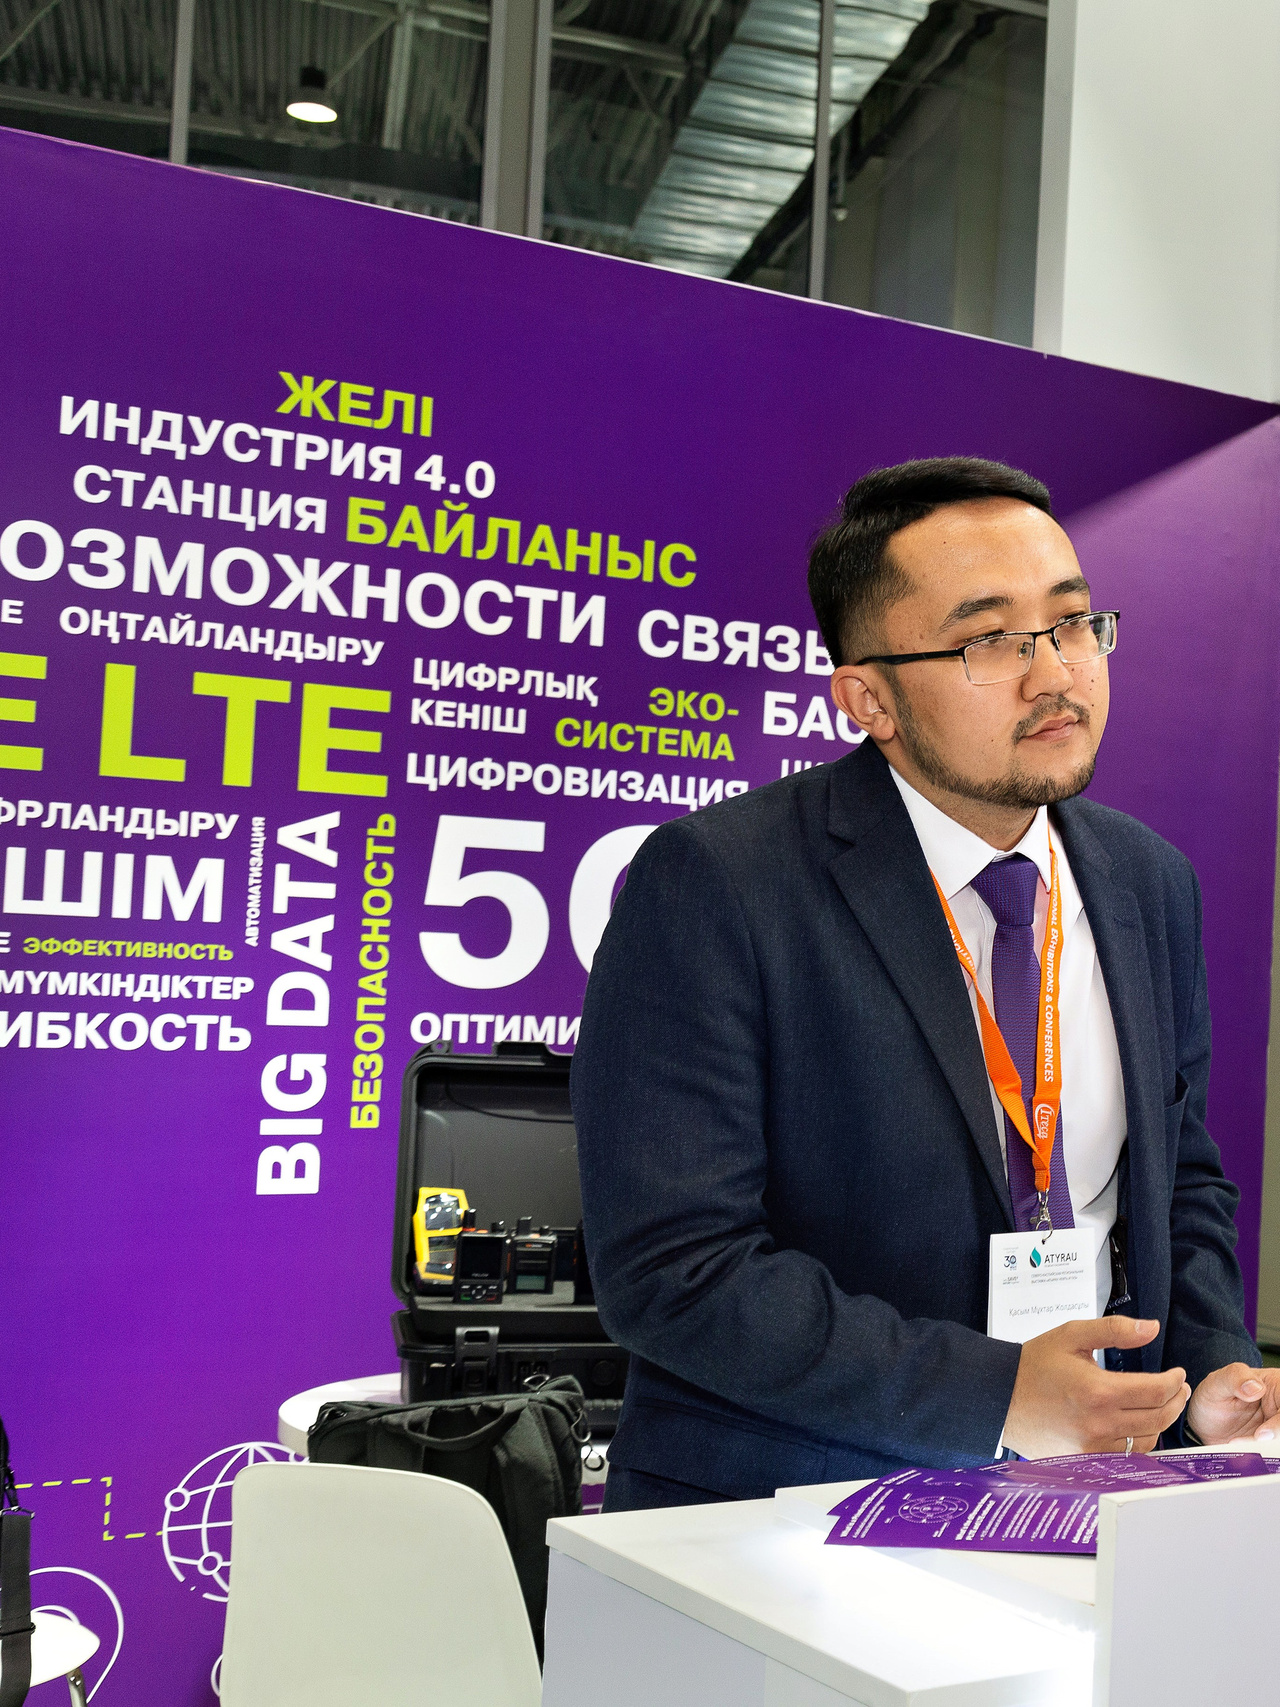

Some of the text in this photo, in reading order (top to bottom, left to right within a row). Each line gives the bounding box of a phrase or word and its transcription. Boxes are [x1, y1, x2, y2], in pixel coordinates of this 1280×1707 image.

[277, 371, 433, 437] ЖЕЛІ
[59, 395, 496, 499] ИНДУСТРИЯ 4.0
[73, 464, 697, 588] СТАНЦИЯ БАЙЛАНЫС
[0, 519, 606, 648] ОЗМОЖНОСТИ
[59, 605, 385, 666] ОҢТАЙЛАНДЫРУ
[637, 609, 836, 676] СВЯЗЬ
[413, 657, 598, 708] ЦИФРЛЫҚ
[648, 687, 740, 721] ЭКО-
[98, 662, 391, 797] LTE
[410, 697, 527, 735] КЕНІШ
[555, 717, 735, 762] СИСТЕМА
[405, 752, 750, 812] ЦИФРОВИЗАЦИЯ
[2, 846, 226, 924] ШІМ
[245, 816, 266, 948] АВТОМАТИЗАЦИЯ
[23, 936, 234, 961] ЭФФЕКТИВНОСТЬ
[350, 813, 396, 1129] БЕЗОПАСНОСТЬ
[1046, 928, 1059, 994] EXHIBITIONS
[0, 969, 255, 1003] МҮМКІНДІКТЕР
[255, 810, 341, 1196] BIG DATA
[1045, 995, 1053, 1003] &
[0, 1010, 252, 1052] ИБКОСТЬ
[410, 1012, 582, 1046] ОПТИМИ
[1043, 1004, 1055, 1083] CONFERENCES
[1044, 1252, 1078, 1264] ATYRAU
